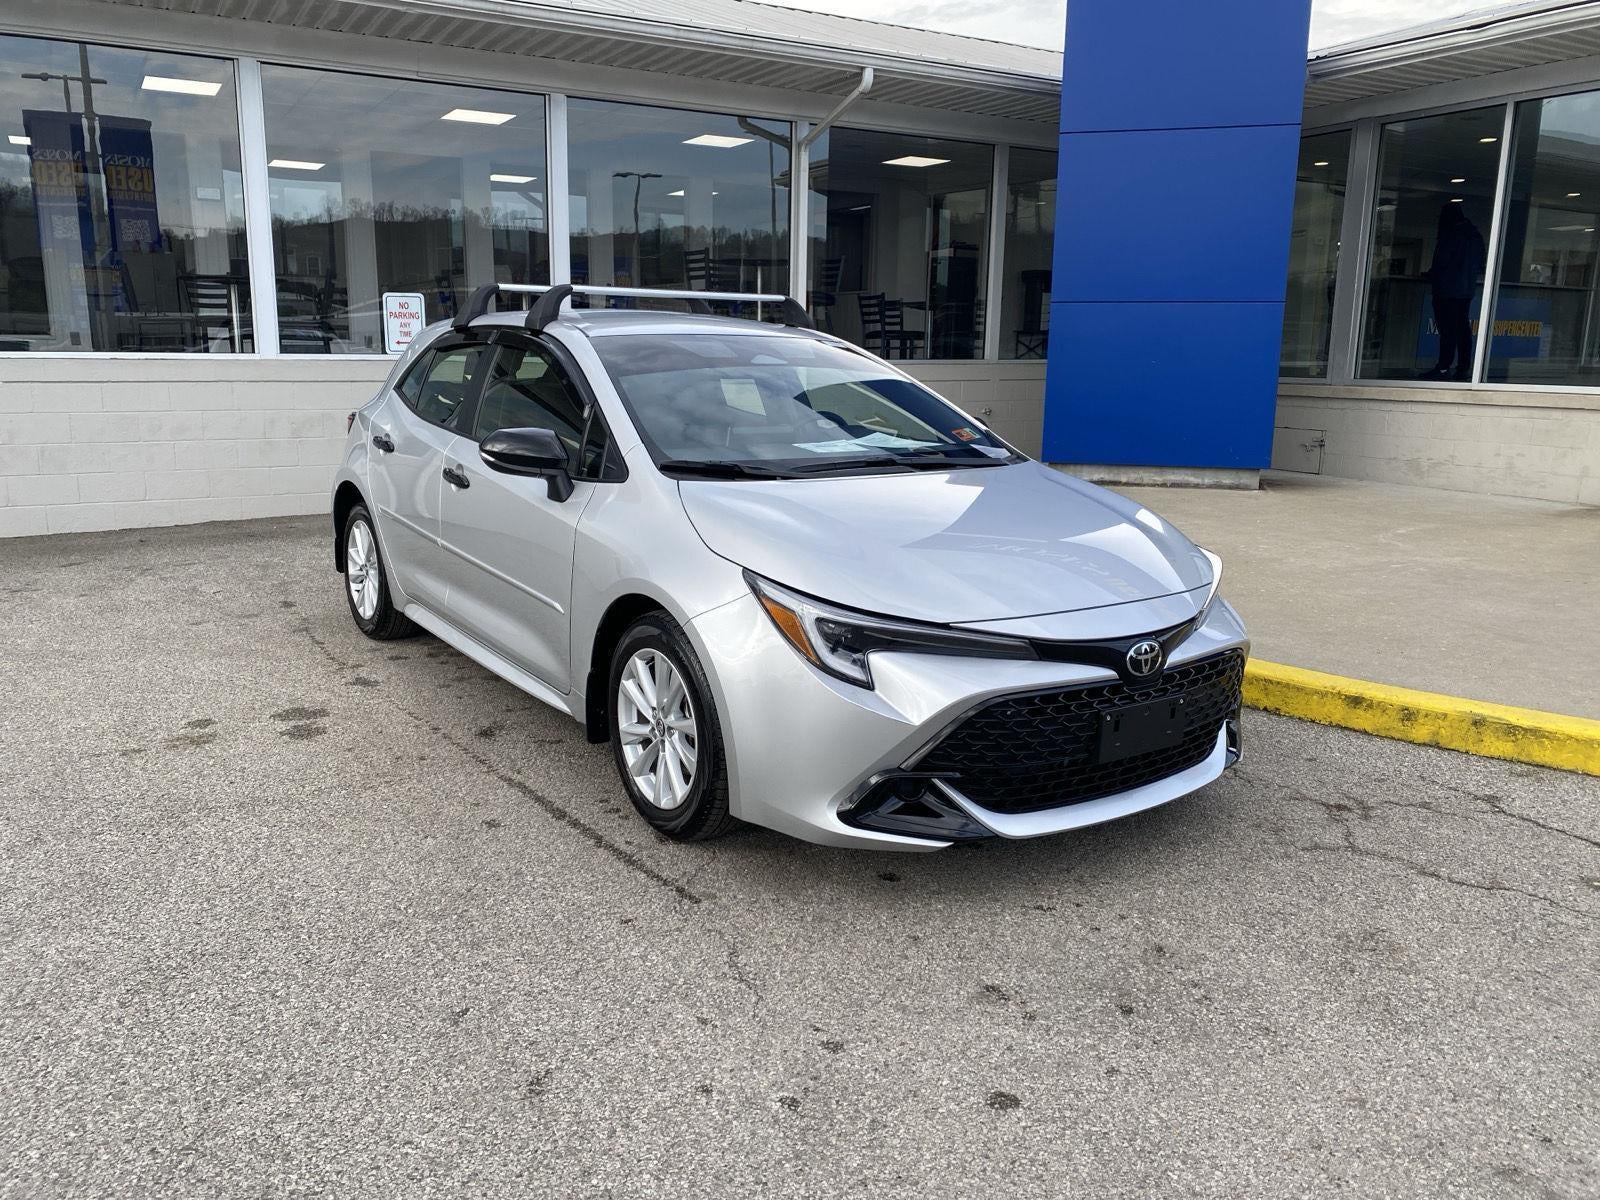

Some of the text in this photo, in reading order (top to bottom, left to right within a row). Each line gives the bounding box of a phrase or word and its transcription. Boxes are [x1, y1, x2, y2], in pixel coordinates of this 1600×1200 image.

[398, 301, 409, 310] NO
[389, 311, 420, 320] PARKING
[400, 321, 411, 329] ANY
[399, 330, 412, 338] TIME
